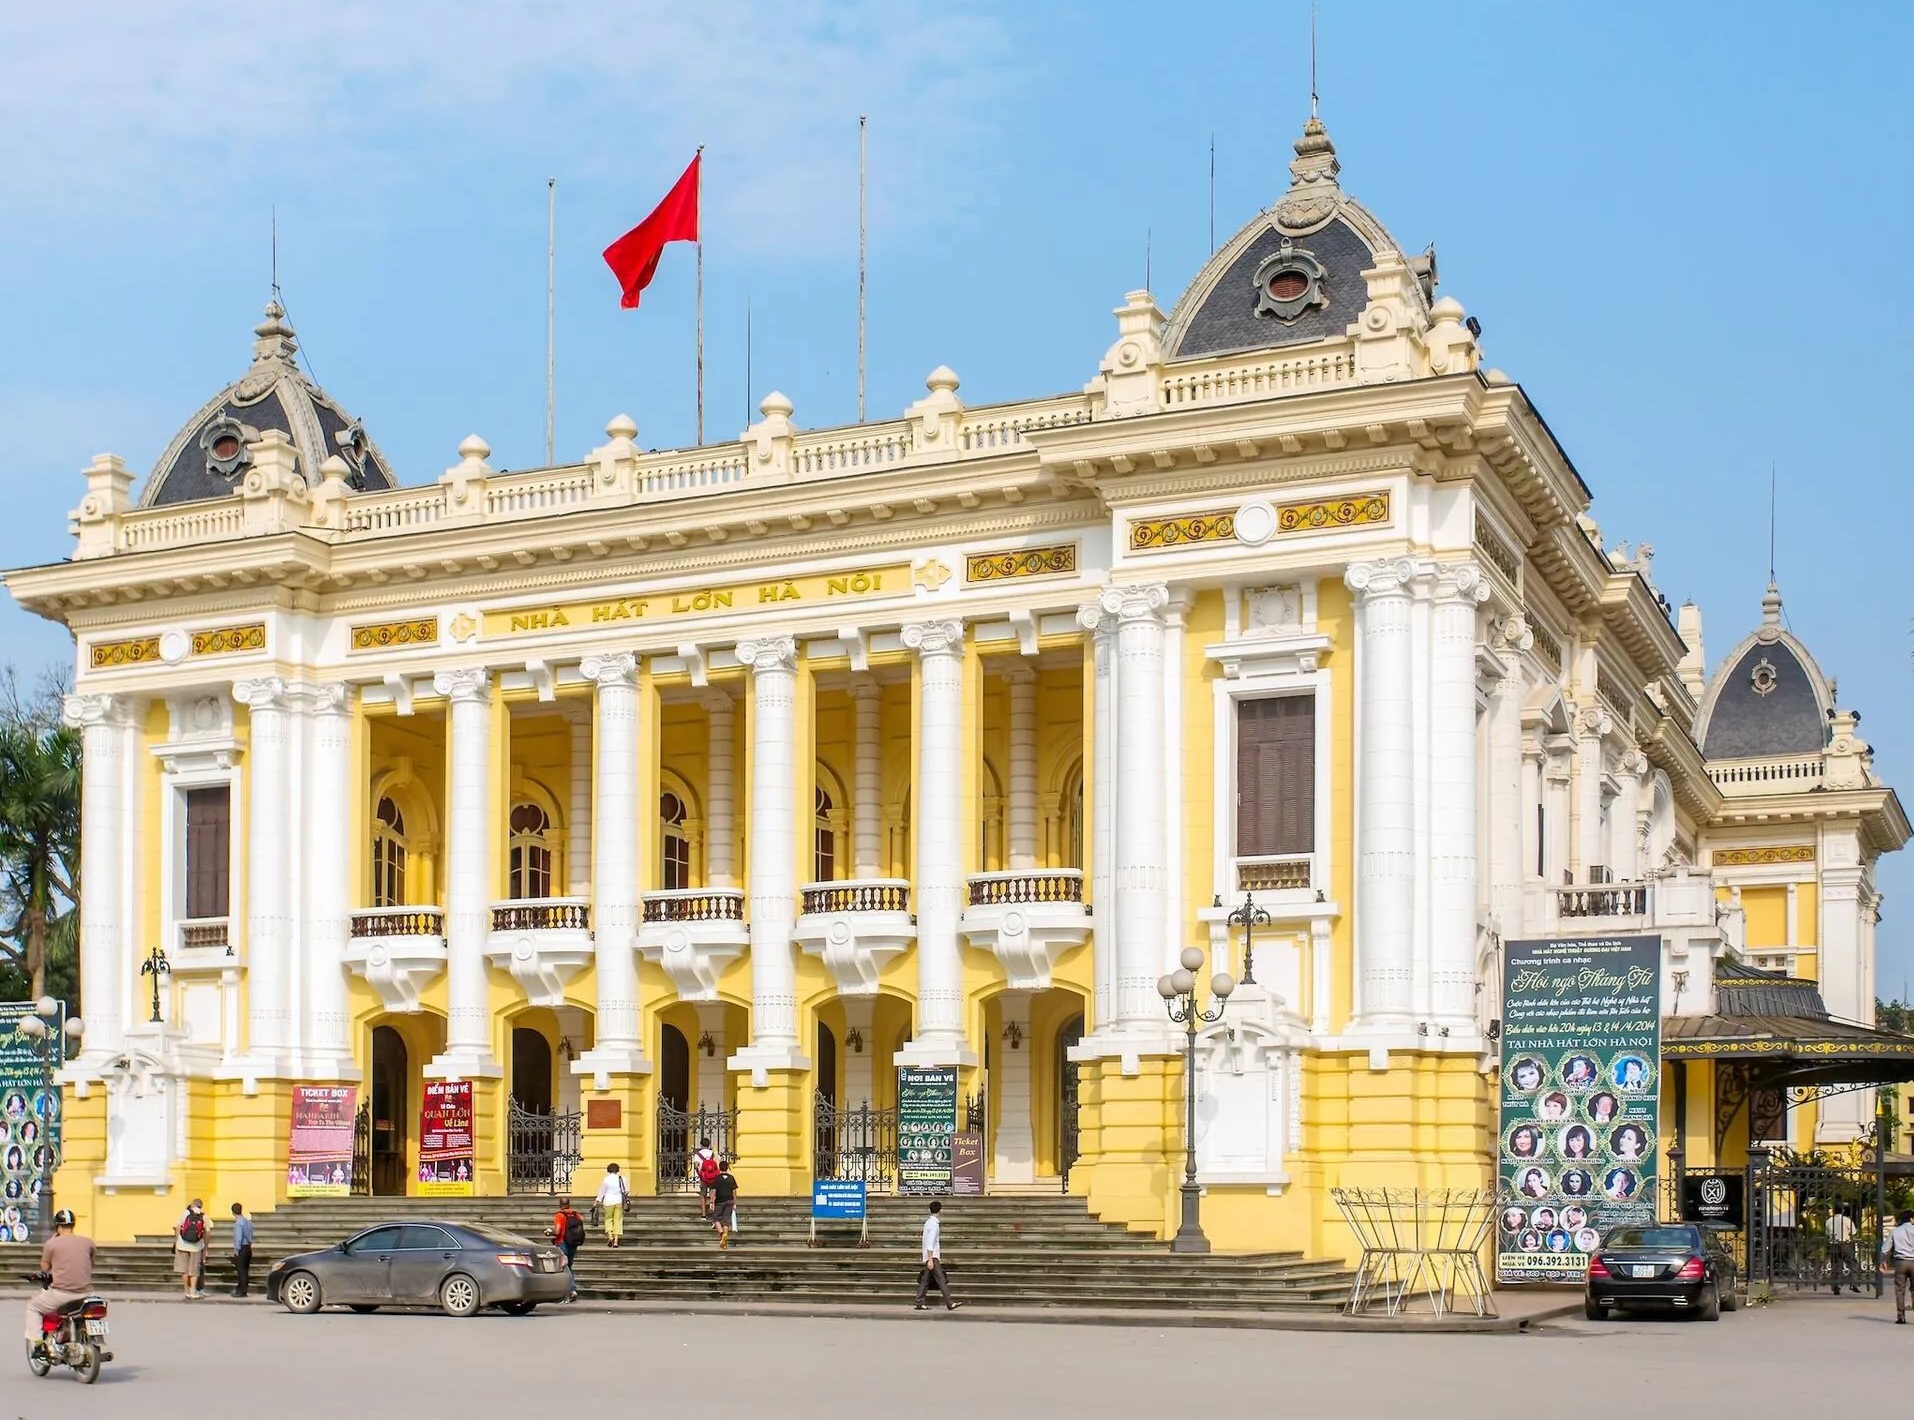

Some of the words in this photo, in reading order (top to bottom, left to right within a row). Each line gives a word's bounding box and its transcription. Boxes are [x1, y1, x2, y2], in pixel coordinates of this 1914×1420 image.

[511, 605, 570, 631] NHÀ
[592, 598, 649, 622] HÁT
[672, 589, 733, 613] LỚN
[759, 579, 806, 603] HÀ
[827, 573, 882, 595] NỘI
[1511, 958, 1542, 966] Chương
[1543, 957, 1561, 965] trình
[1573, 956, 1592, 965] nhạc
[1577, 966, 1626, 995] Tháng
[1559, 1022, 1576, 1033] 20h
[1592, 1021, 1602, 1032] 13
[1603, 1022, 1610, 1034] &
[1507, 1040, 1527, 1050] TẠI
[1528, 1038, 1553, 1048] NHÀ
[1556, 1037, 1580, 1048] HÁT
[1583, 1037, 1607, 1047] LỚN
[1609, 1036, 1628, 1046] HÀ
[1629, 1037, 1652, 1047] NỘI
[924, 1074, 942, 1082] BÁN
[943, 1074, 954, 1082] VÉ
[300, 1088, 330, 1097] TICKET
[331, 1088, 348, 1097] BOX
[445, 1083, 459, 1093] BÁN
[460, 1082, 469, 1093] VÉ
[954, 1137, 978, 1145] Ticket
[959, 1148, 976, 1156] Box
[1707, 1187, 1720, 1198] XI
[1527, 1256, 1585, 1266] 096.392.3131
